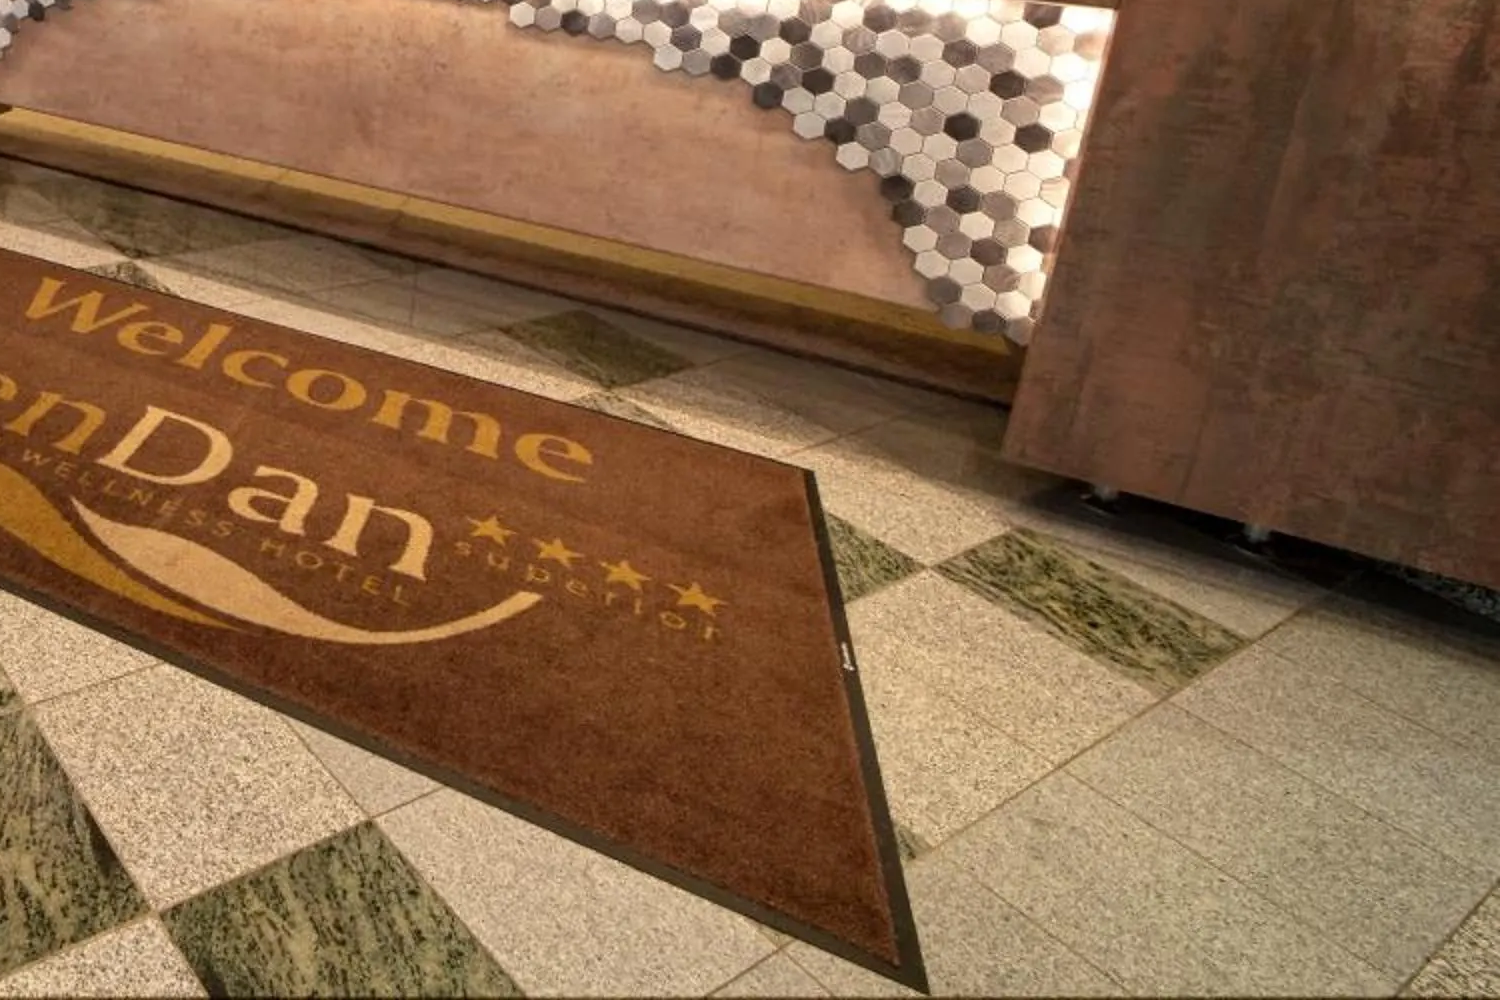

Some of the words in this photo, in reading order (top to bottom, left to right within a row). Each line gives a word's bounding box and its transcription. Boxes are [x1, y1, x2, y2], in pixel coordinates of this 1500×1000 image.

[23, 276, 594, 484] Welcome
[20, 448, 232, 539] WELLNESS
[259, 536, 412, 607] HOTEL
[453, 539, 722, 642] superior
